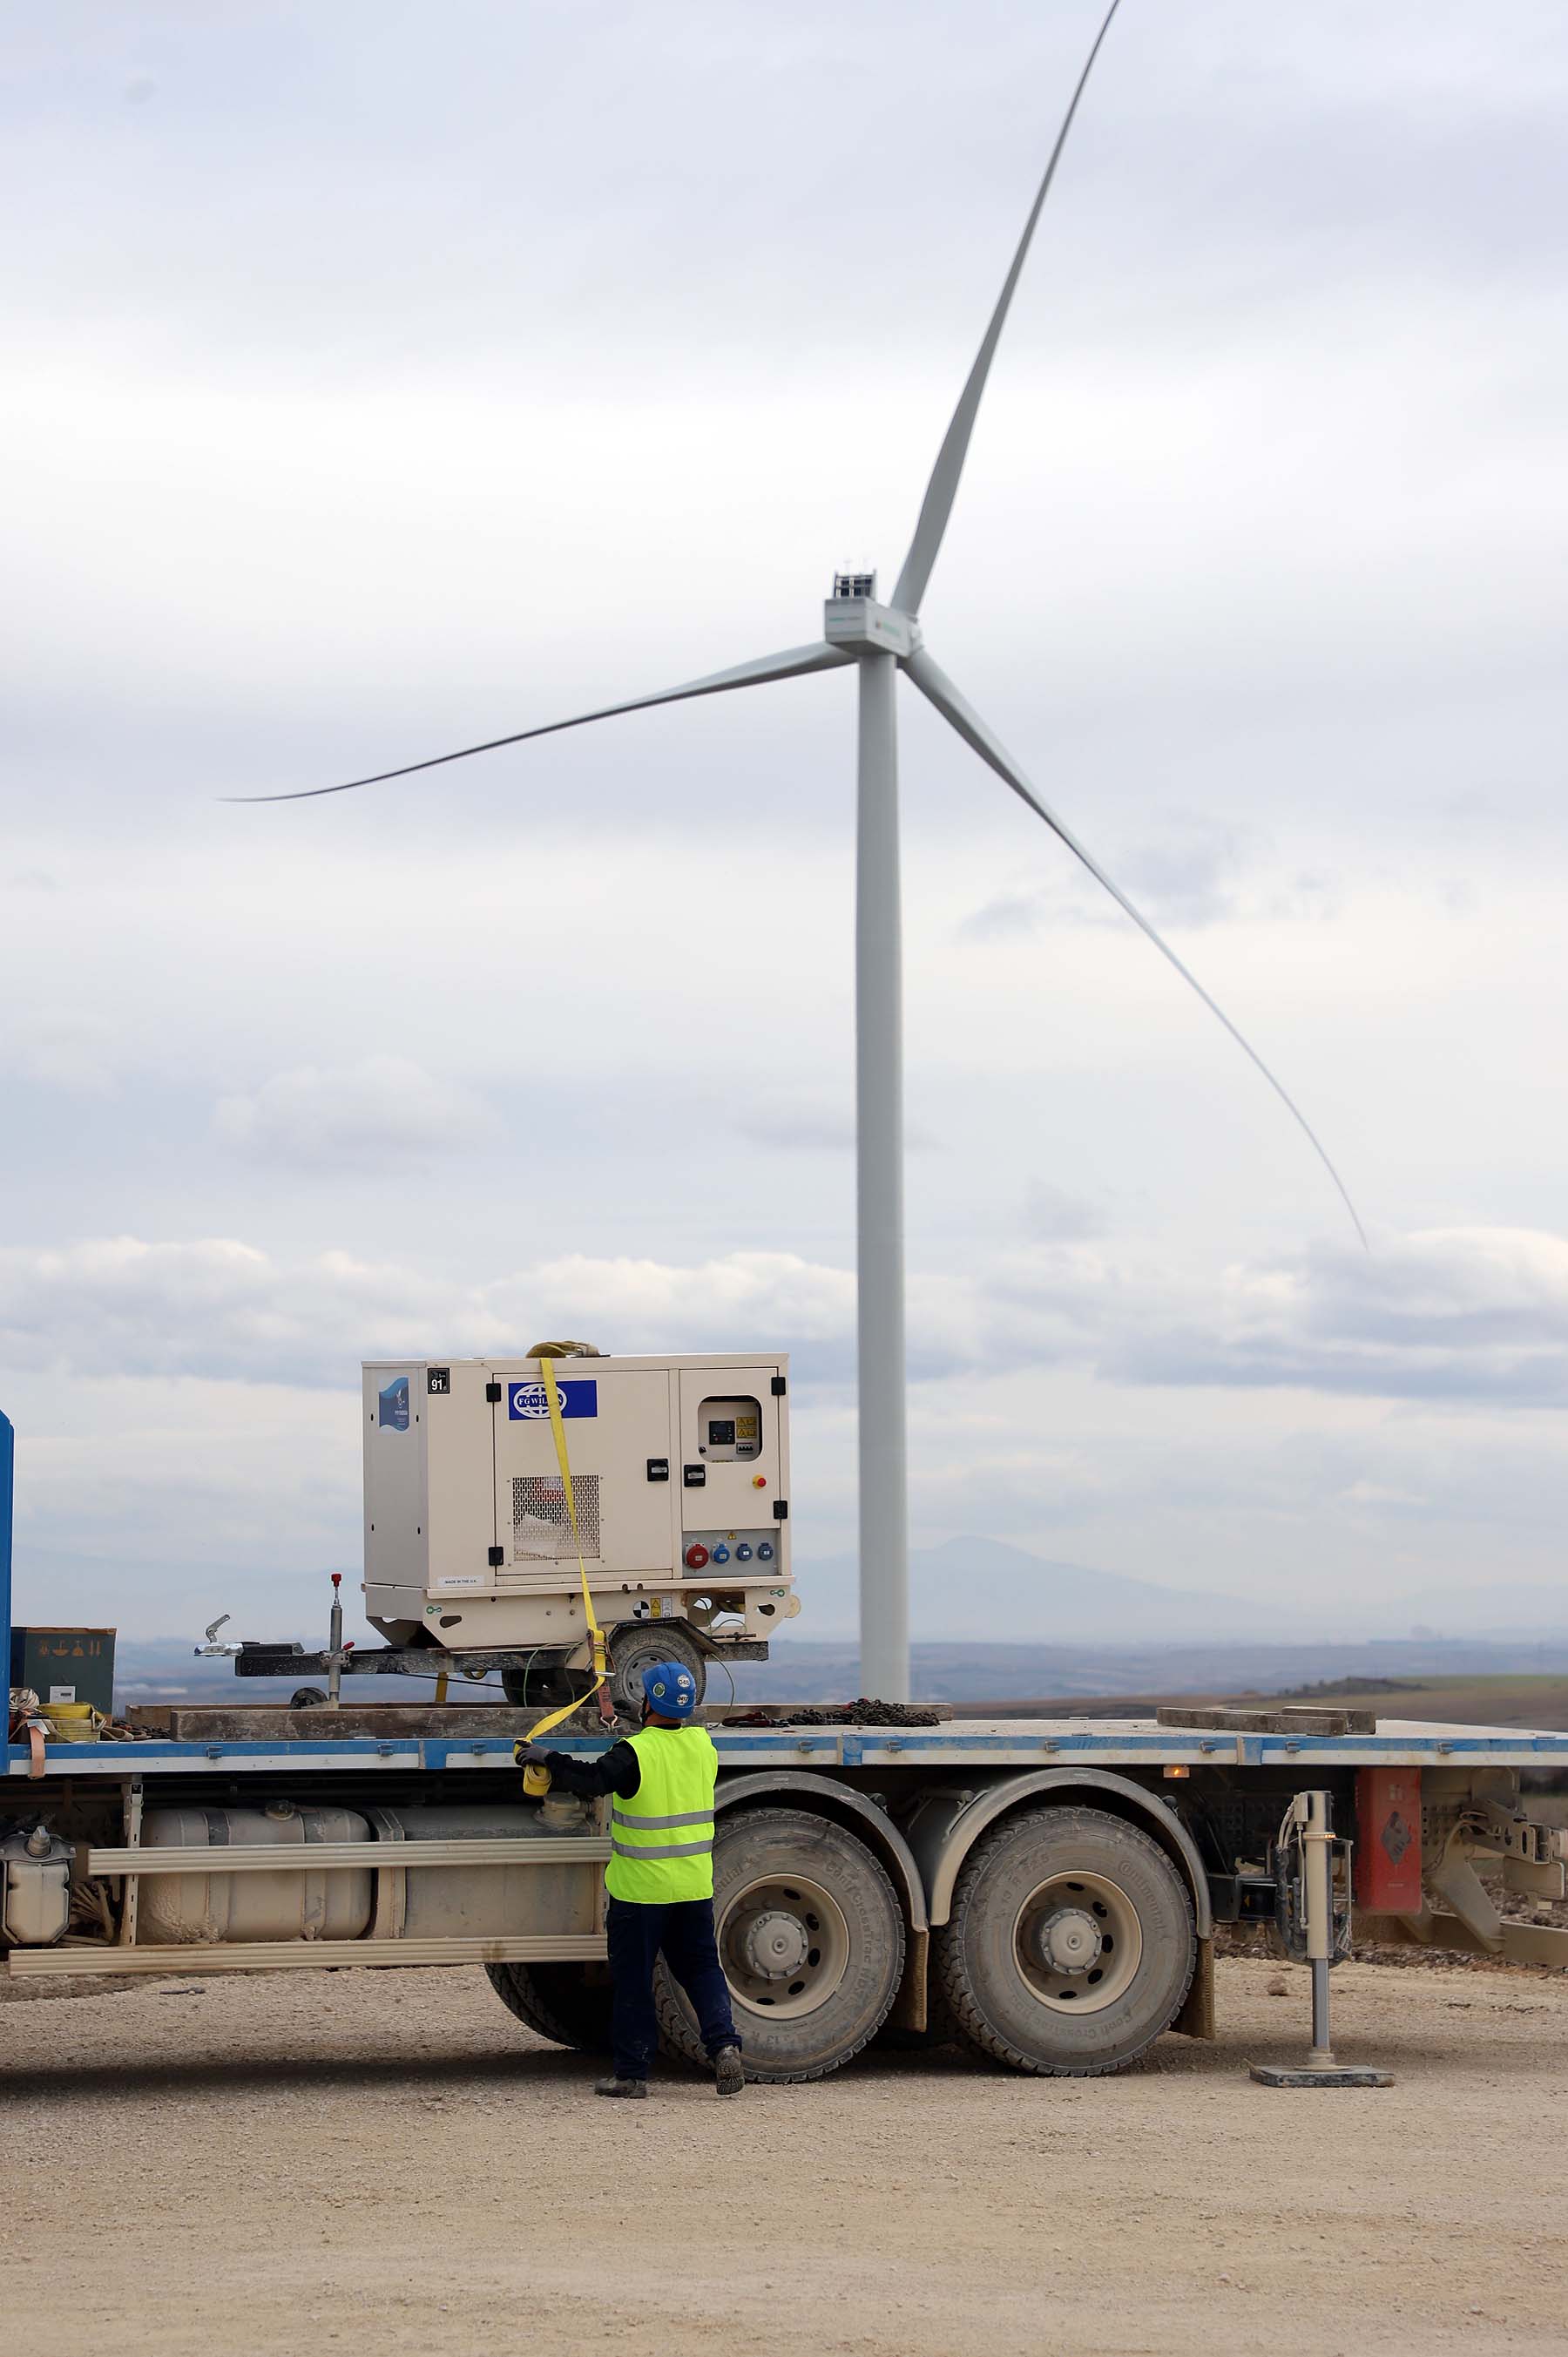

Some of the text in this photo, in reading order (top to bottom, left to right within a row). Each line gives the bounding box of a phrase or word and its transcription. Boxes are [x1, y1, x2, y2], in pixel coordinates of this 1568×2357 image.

[431, 1379, 443, 1391] 91
[531, 1396, 563, 1405] WILN
[1118, 1859, 1166, 1931] Continental
